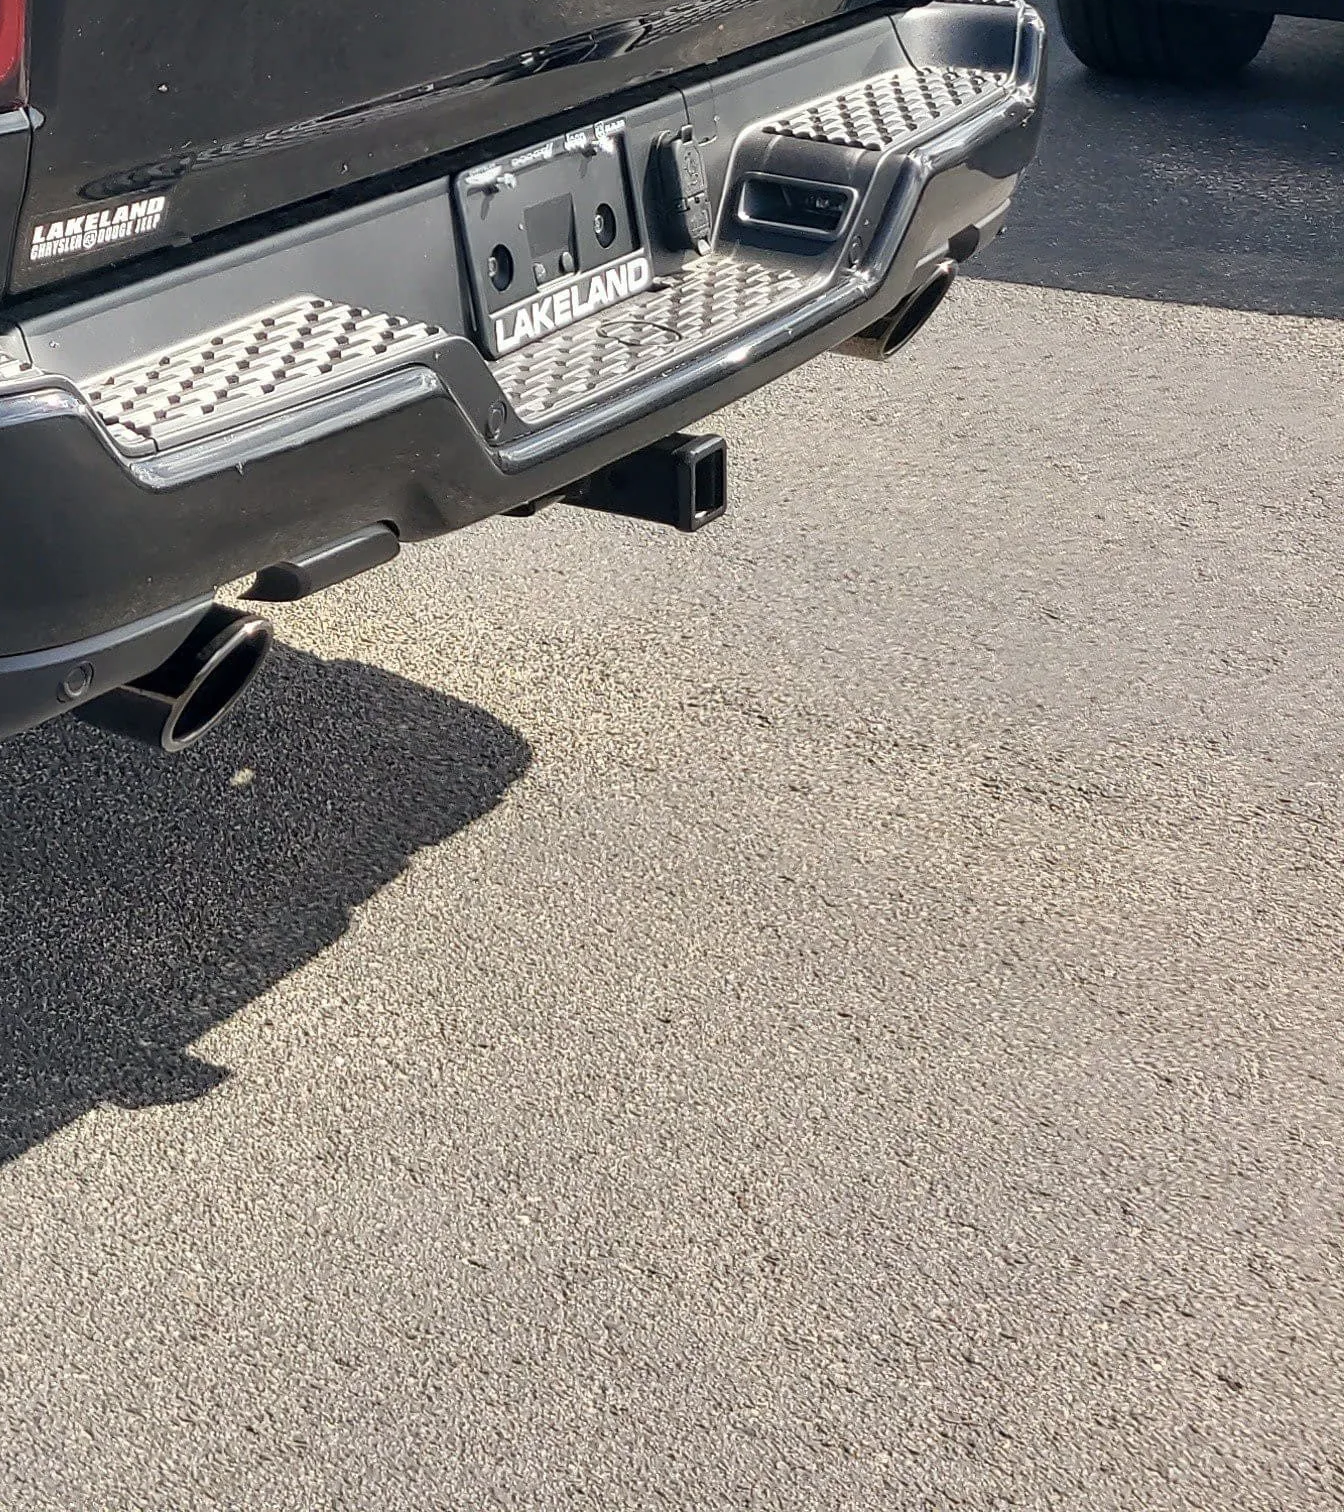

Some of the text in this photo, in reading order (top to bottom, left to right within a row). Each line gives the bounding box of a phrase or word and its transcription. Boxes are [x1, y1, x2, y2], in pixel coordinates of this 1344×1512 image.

[30, 213, 162, 261] CHRYSLER DODGE JEEP
[31, 196, 166, 245] LAKELAND
[494, 256, 650, 354] LAKELAND
